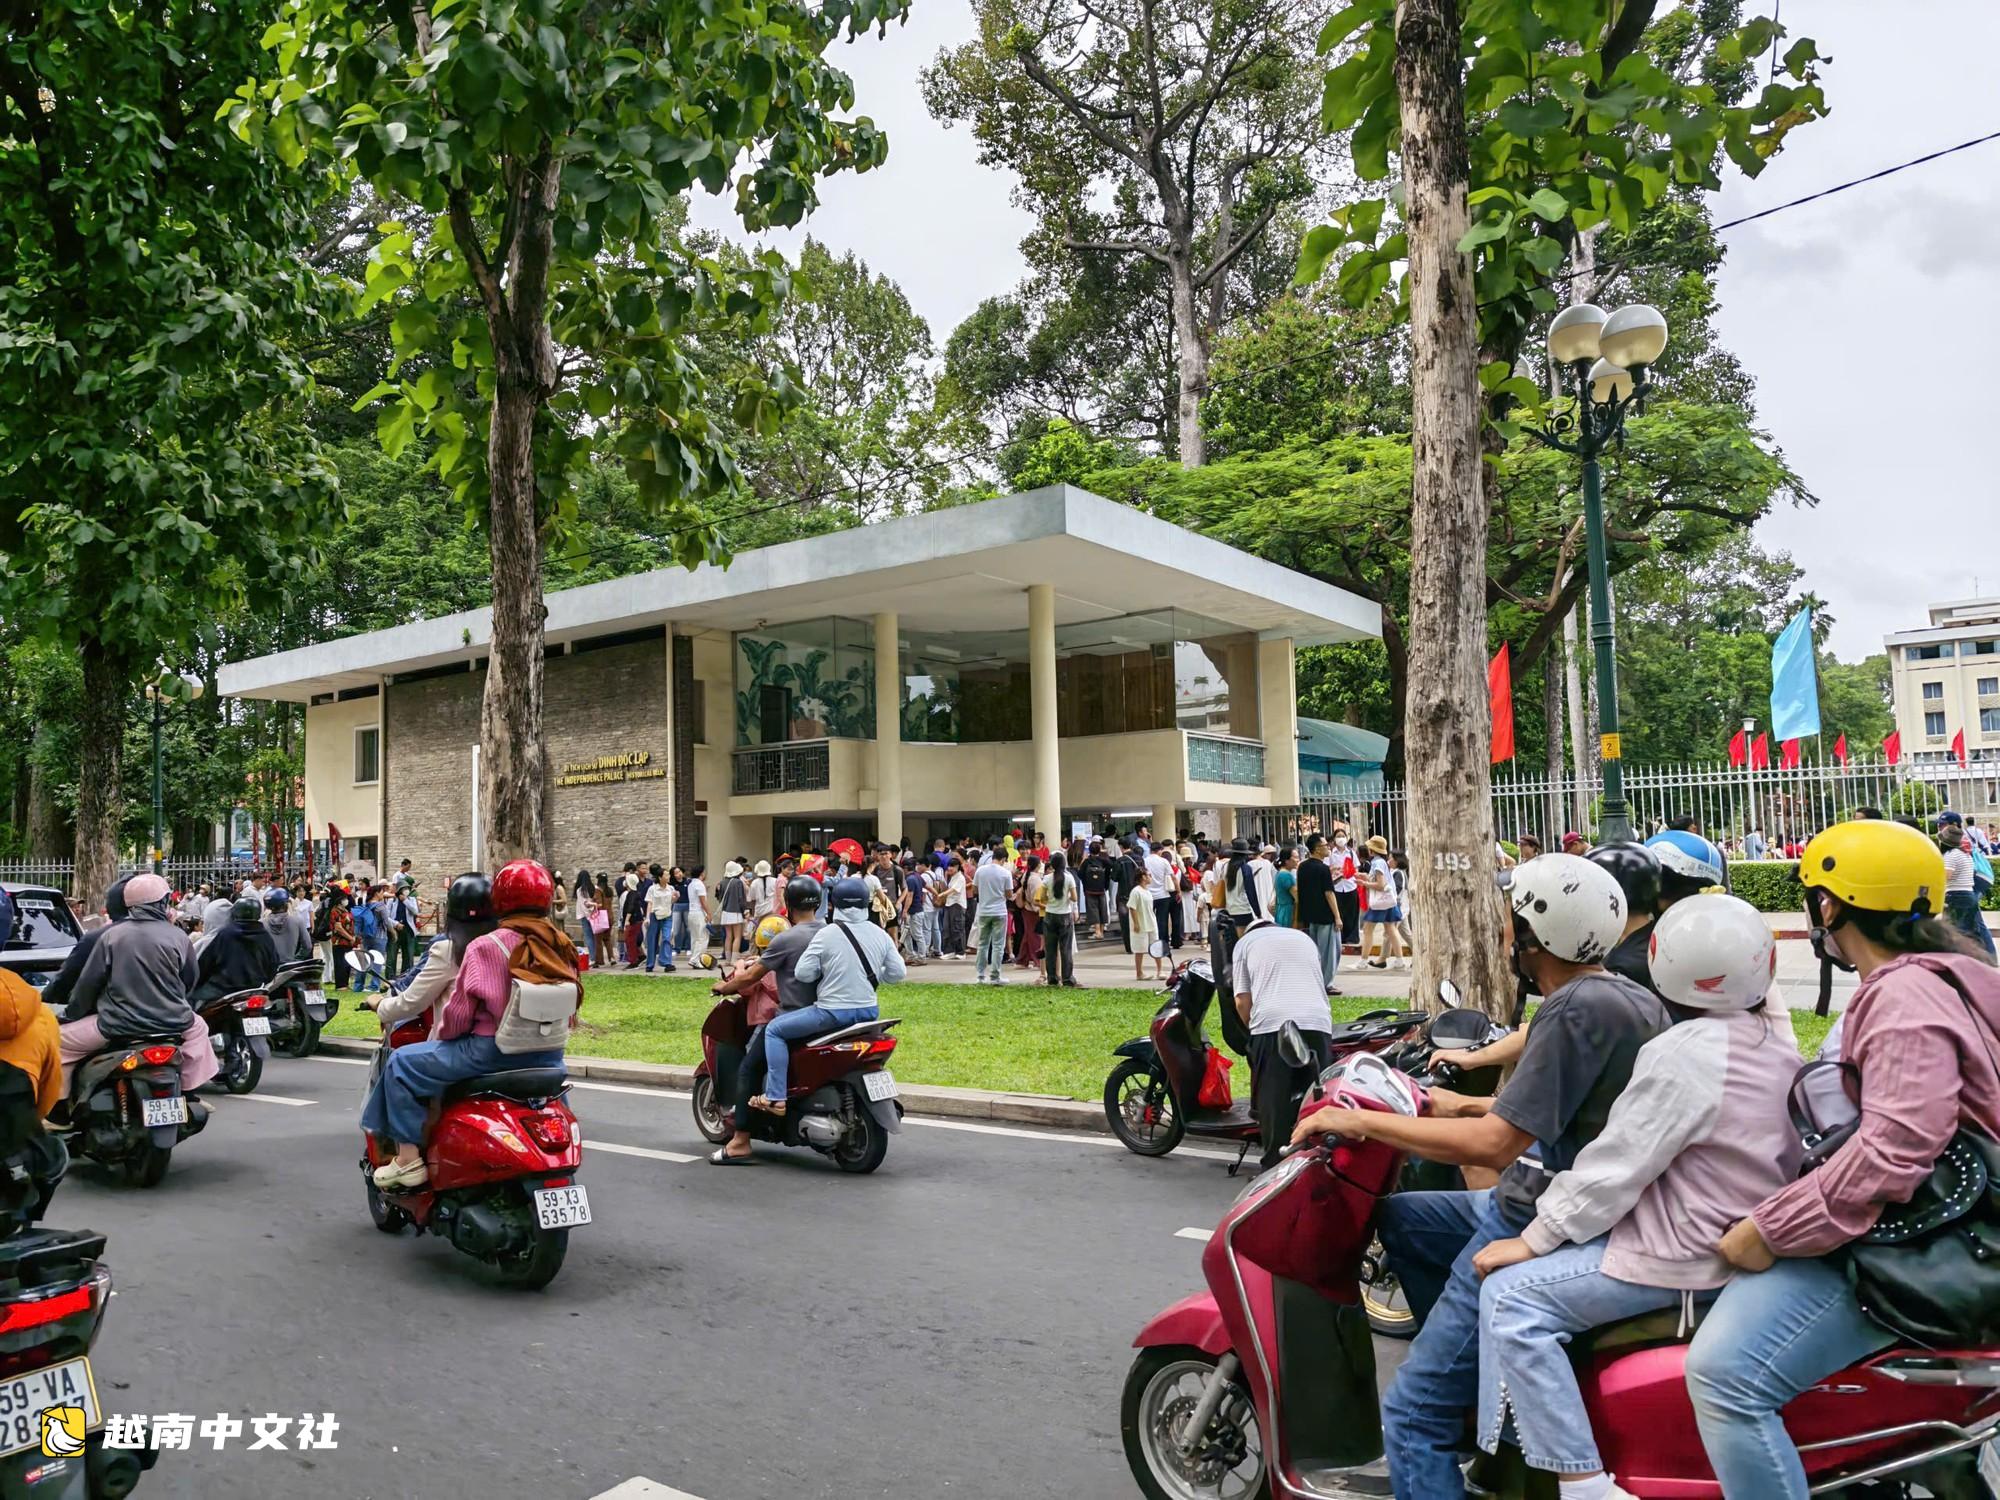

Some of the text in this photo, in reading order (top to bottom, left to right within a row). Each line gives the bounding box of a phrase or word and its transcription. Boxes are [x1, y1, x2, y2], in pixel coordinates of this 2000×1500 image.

[599, 755, 618, 769] DINH
[553, 775, 565, 787] THE
[564, 772, 604, 785] INDEPENDENCE
[604, 769, 624, 781] PALACE
[1434, 852, 1471, 870] 193
[149, 1099, 180, 1112] 59-TA
[542, 1189, 579, 1208] 59-X3
[541, 1205, 588, 1226] 535.78
[0, 1367, 76, 1415] 59-VA
